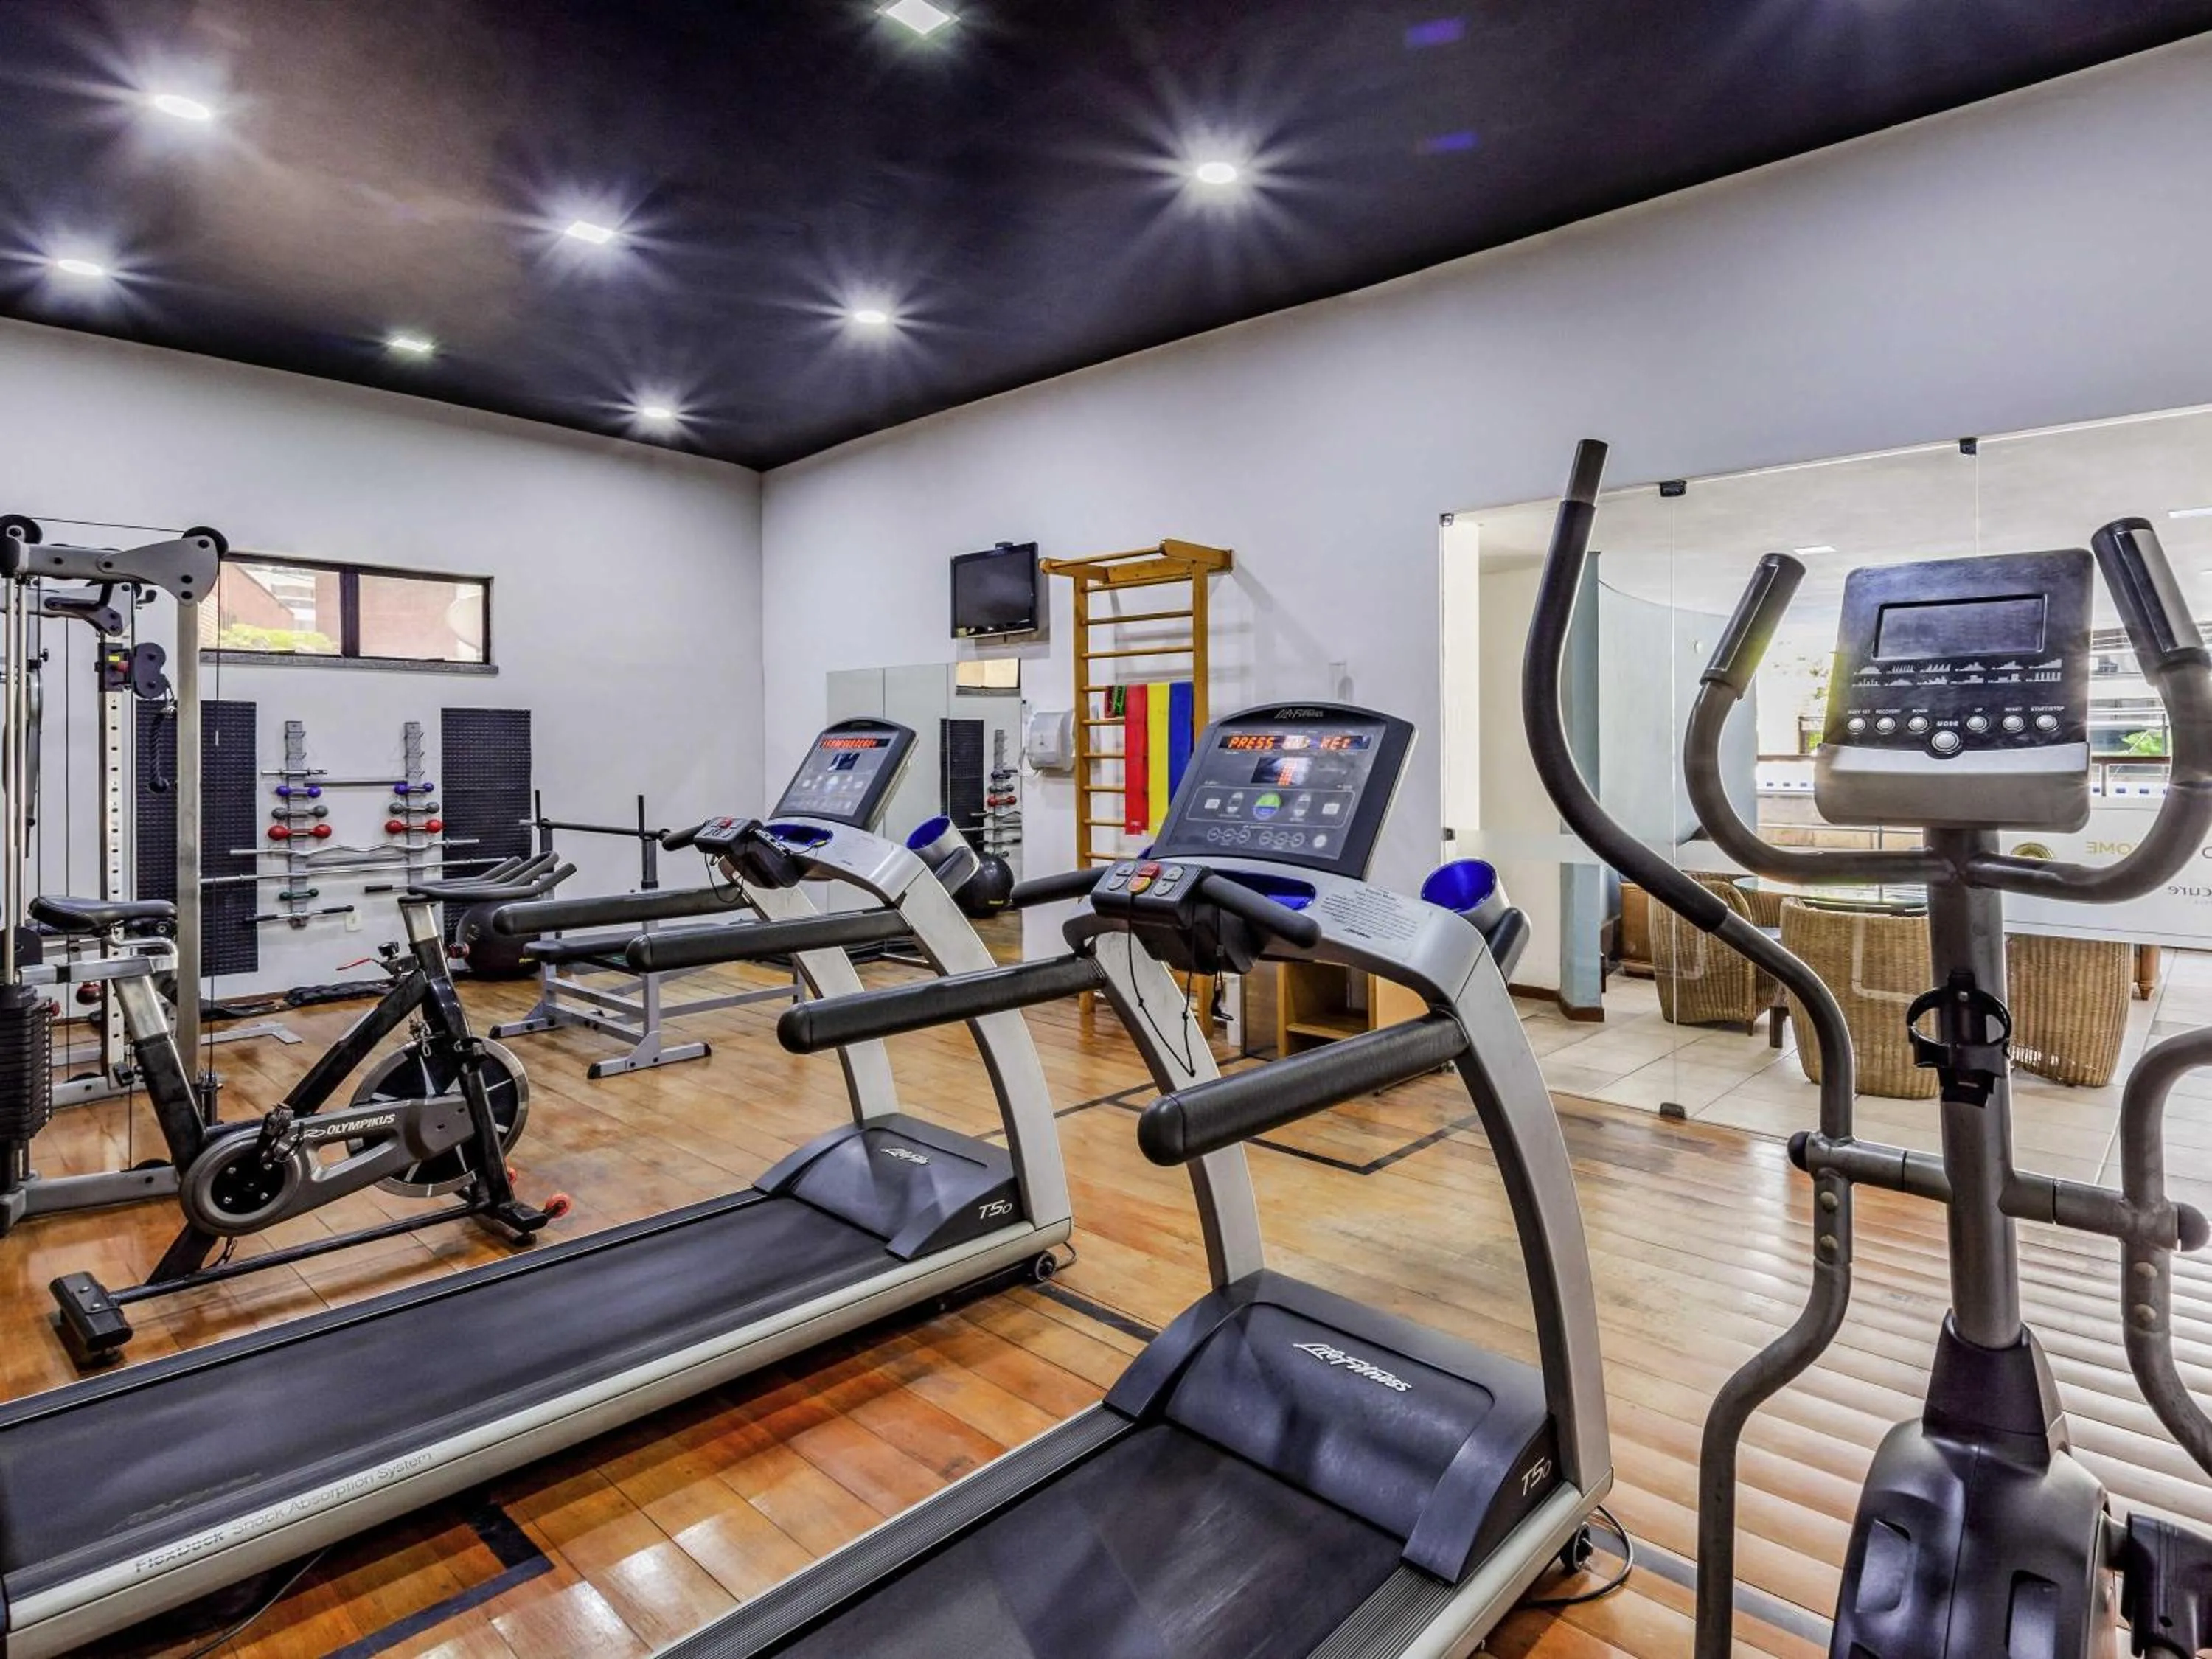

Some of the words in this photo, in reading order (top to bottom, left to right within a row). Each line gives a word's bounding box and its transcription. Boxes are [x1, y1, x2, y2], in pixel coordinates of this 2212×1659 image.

[1228, 737, 1275, 750] PRESS
[327, 1114, 395, 1135] OLYMPIKUS
[288, 1475, 374, 1514] Absorption
[377, 1451, 432, 1481] System
